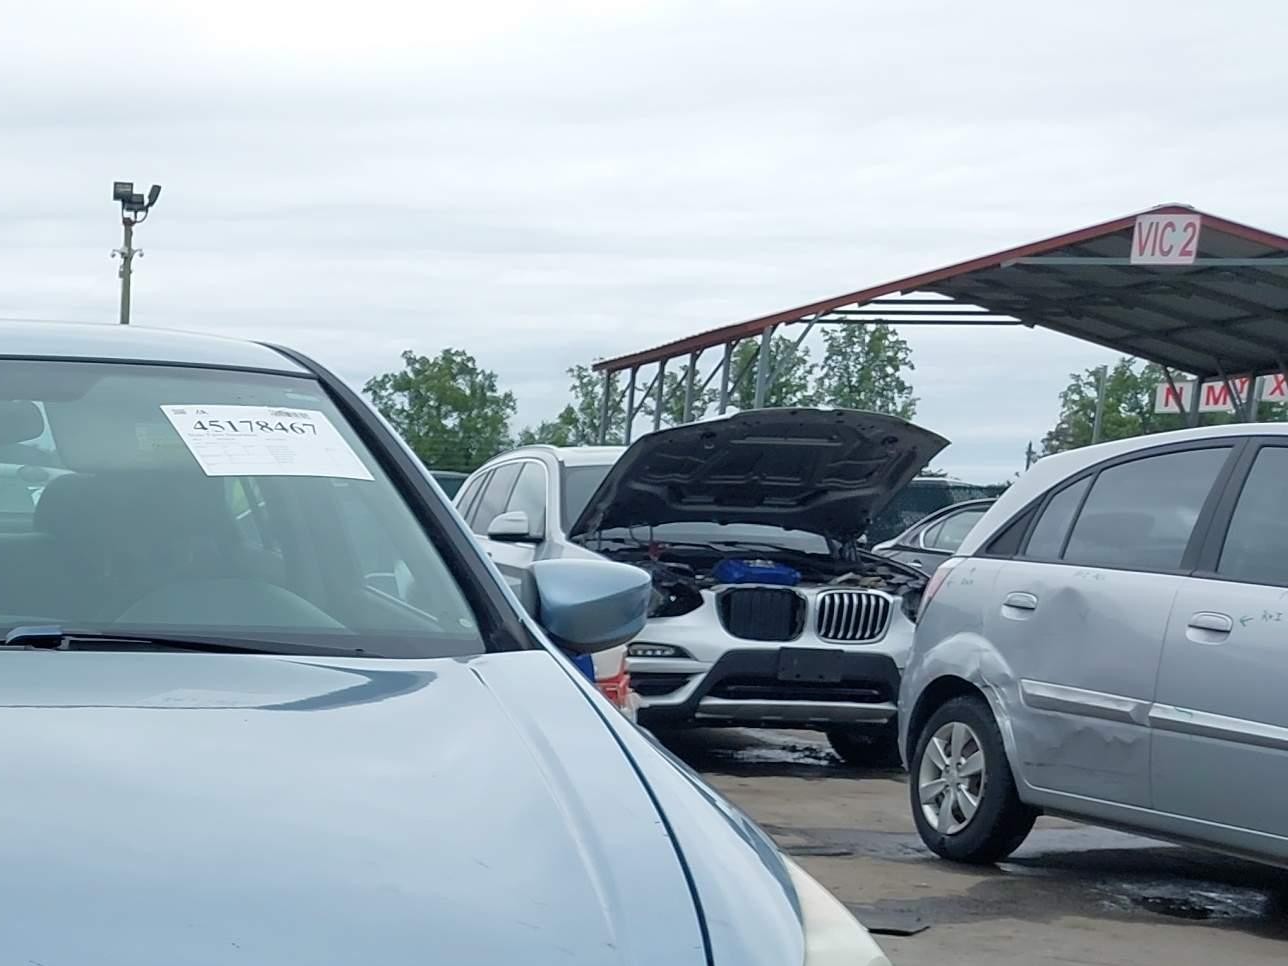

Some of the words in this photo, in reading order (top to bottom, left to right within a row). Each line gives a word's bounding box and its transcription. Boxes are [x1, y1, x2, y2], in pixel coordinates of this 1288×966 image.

[1137, 221, 1176, 257] VIC
[1179, 221, 1198, 257] 2
[1164, 385, 1184, 407] N
[1205, 385, 1229, 406] M
[193, 420, 317, 435] 45178467
